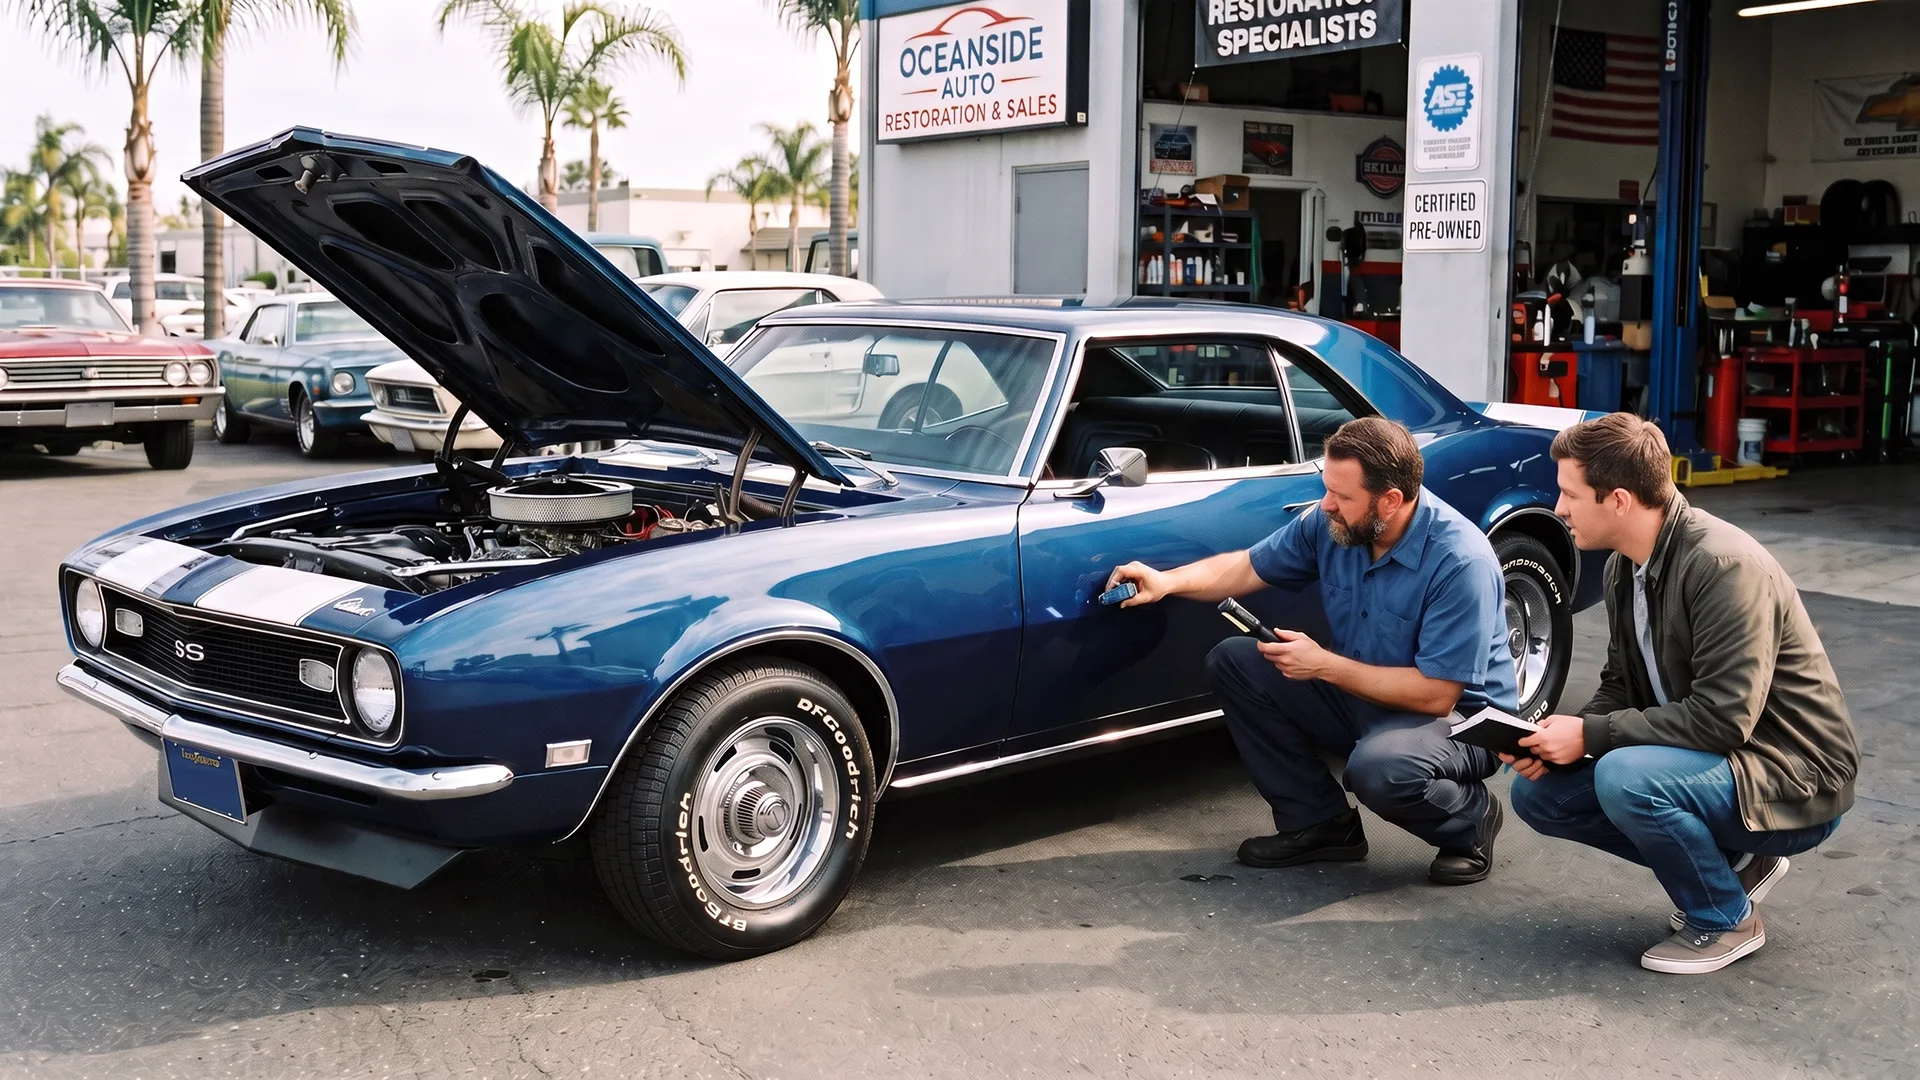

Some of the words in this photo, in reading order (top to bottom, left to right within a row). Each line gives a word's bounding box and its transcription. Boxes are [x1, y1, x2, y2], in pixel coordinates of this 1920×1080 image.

[1217, 9, 1377, 57] SPECIALISTS
[900, 26, 1043, 78] OCEANSIDE
[941, 72, 995, 99] AUTO
[1427, 83, 1468, 109] ASE
[885, 103, 986, 132] RESTORATION
[991, 100, 1001, 120] &
[1007, 94, 1057, 119] SALES
[1414, 192, 1476, 213] CERTIFIED
[1409, 220, 1481, 240] PRE-OWNED
[175, 640, 205, 661] SS
